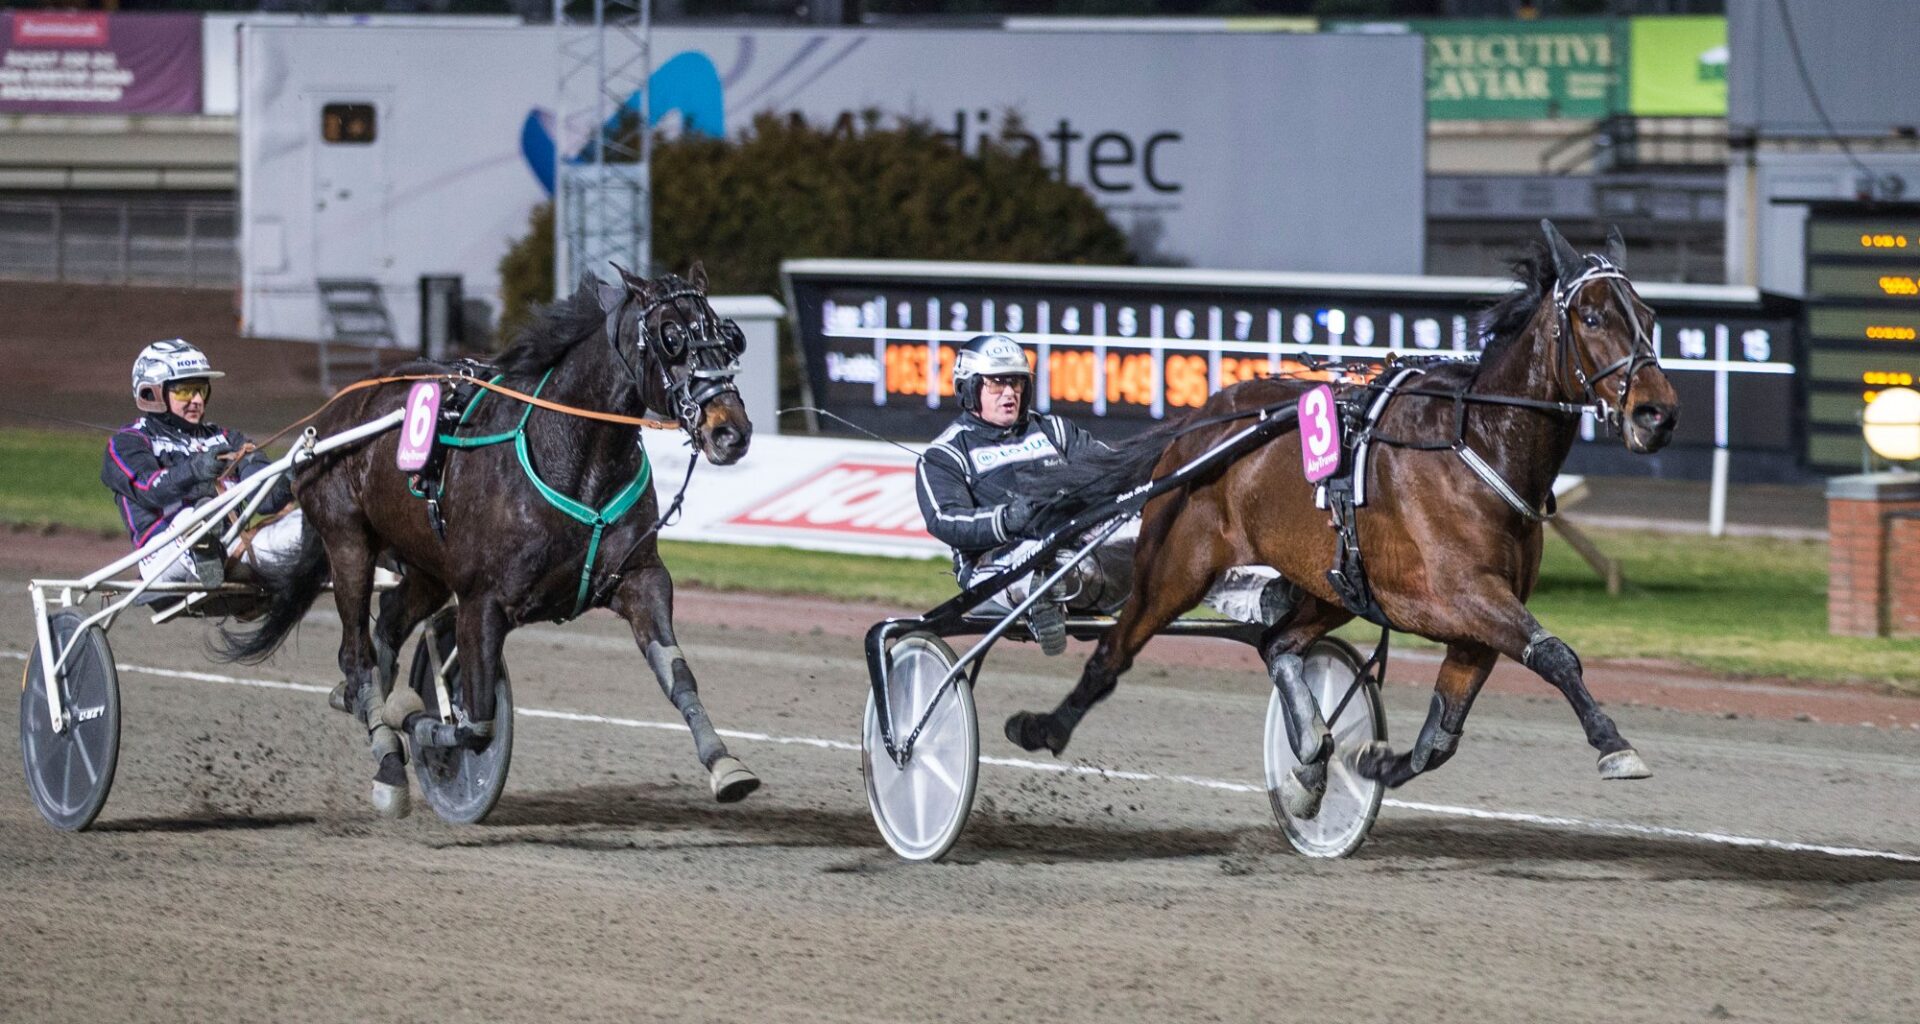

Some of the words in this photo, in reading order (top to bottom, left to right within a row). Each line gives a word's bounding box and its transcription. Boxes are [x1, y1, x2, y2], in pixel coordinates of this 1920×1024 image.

[1428, 34, 1612, 68] XECUTIVE
[950, 302, 969, 332] 2
[1005, 303, 1024, 333] 3
[1062, 307, 1080, 335] 4
[1118, 307, 1138, 337] 5
[1174, 309, 1196, 340] 6
[1235, 311, 1253, 341] 7
[1292, 313, 1314, 344] 8
[1353, 315, 1375, 346] 9
[409, 384, 434, 448] 6
[1305, 389, 1331, 456] 3
